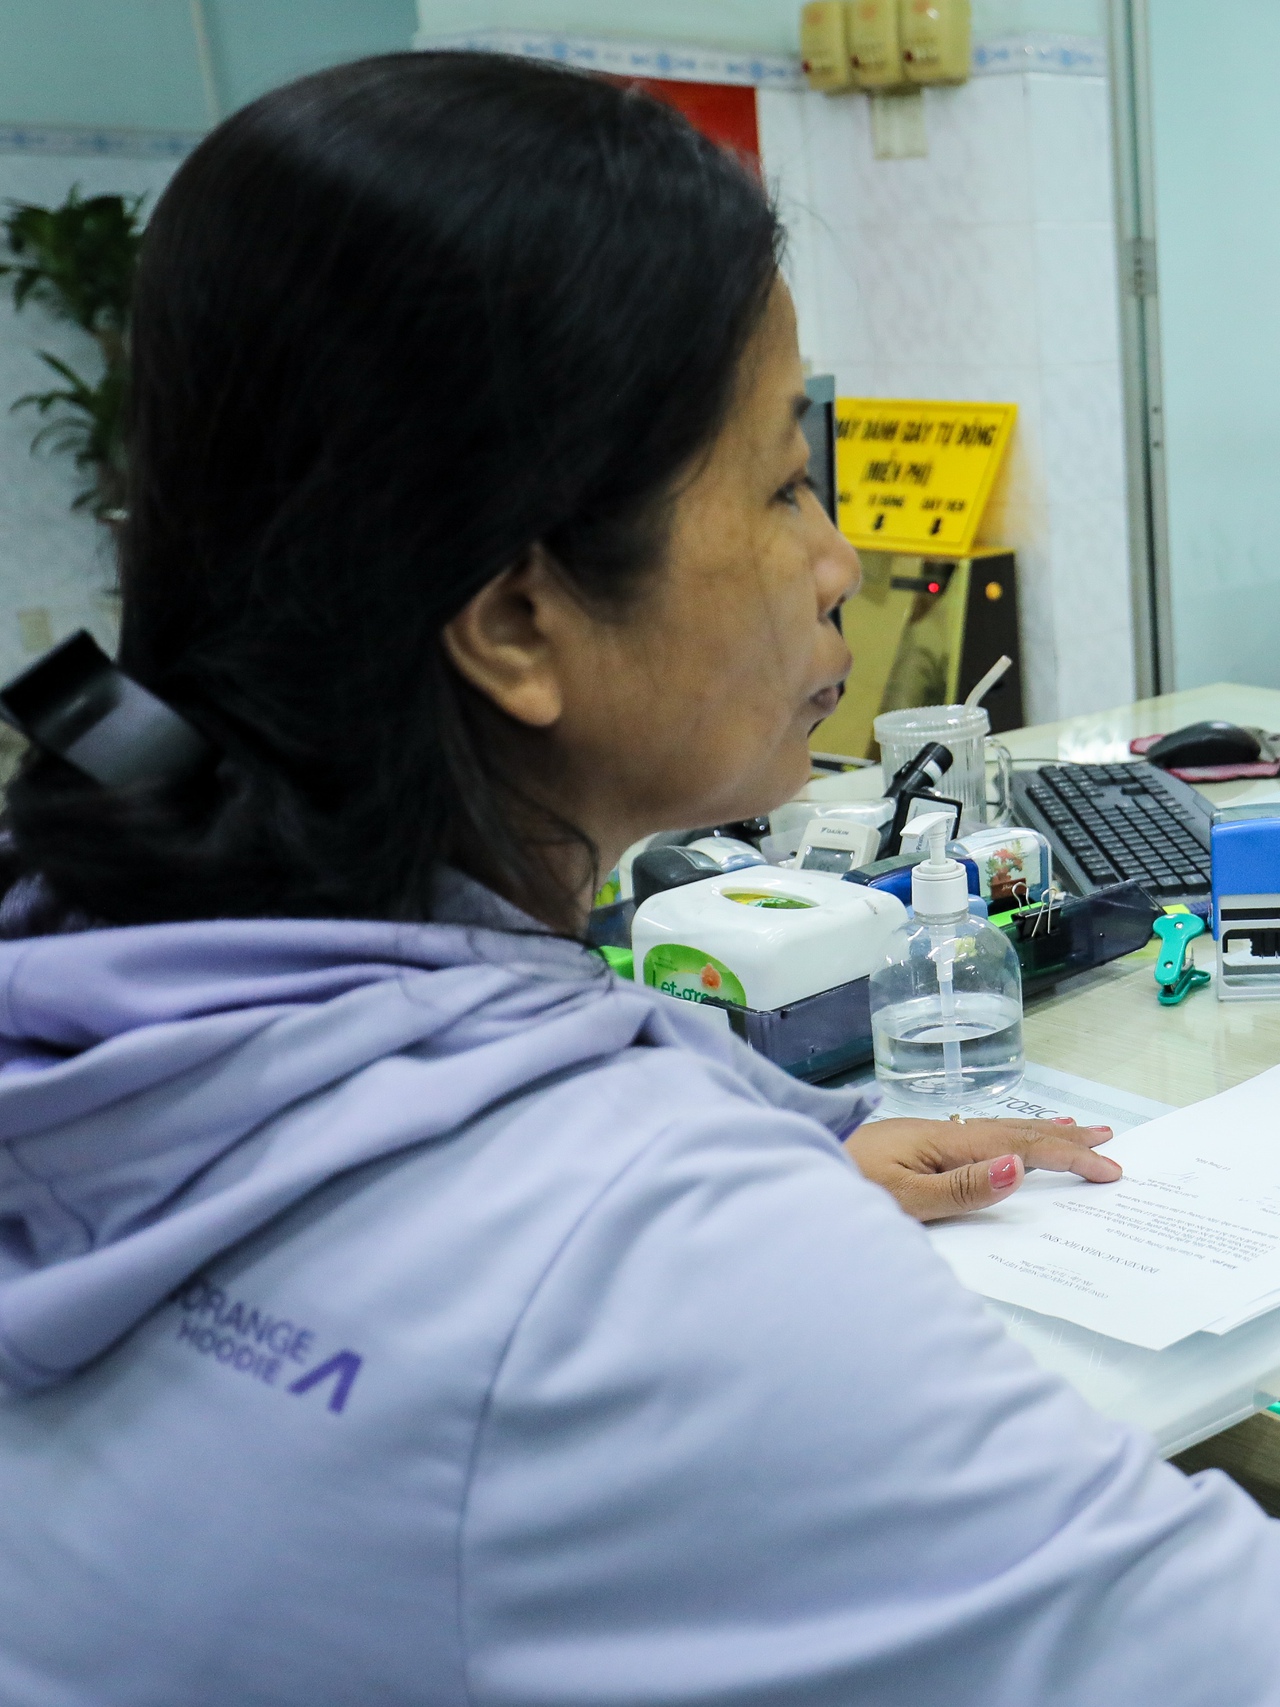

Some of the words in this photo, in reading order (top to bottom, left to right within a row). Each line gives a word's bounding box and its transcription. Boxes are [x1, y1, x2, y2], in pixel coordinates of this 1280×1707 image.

[826, 828, 850, 836] DAIKIN
[996, 1096, 1058, 1119] TOEIC
[1039, 1232, 1060, 1244] SINH
